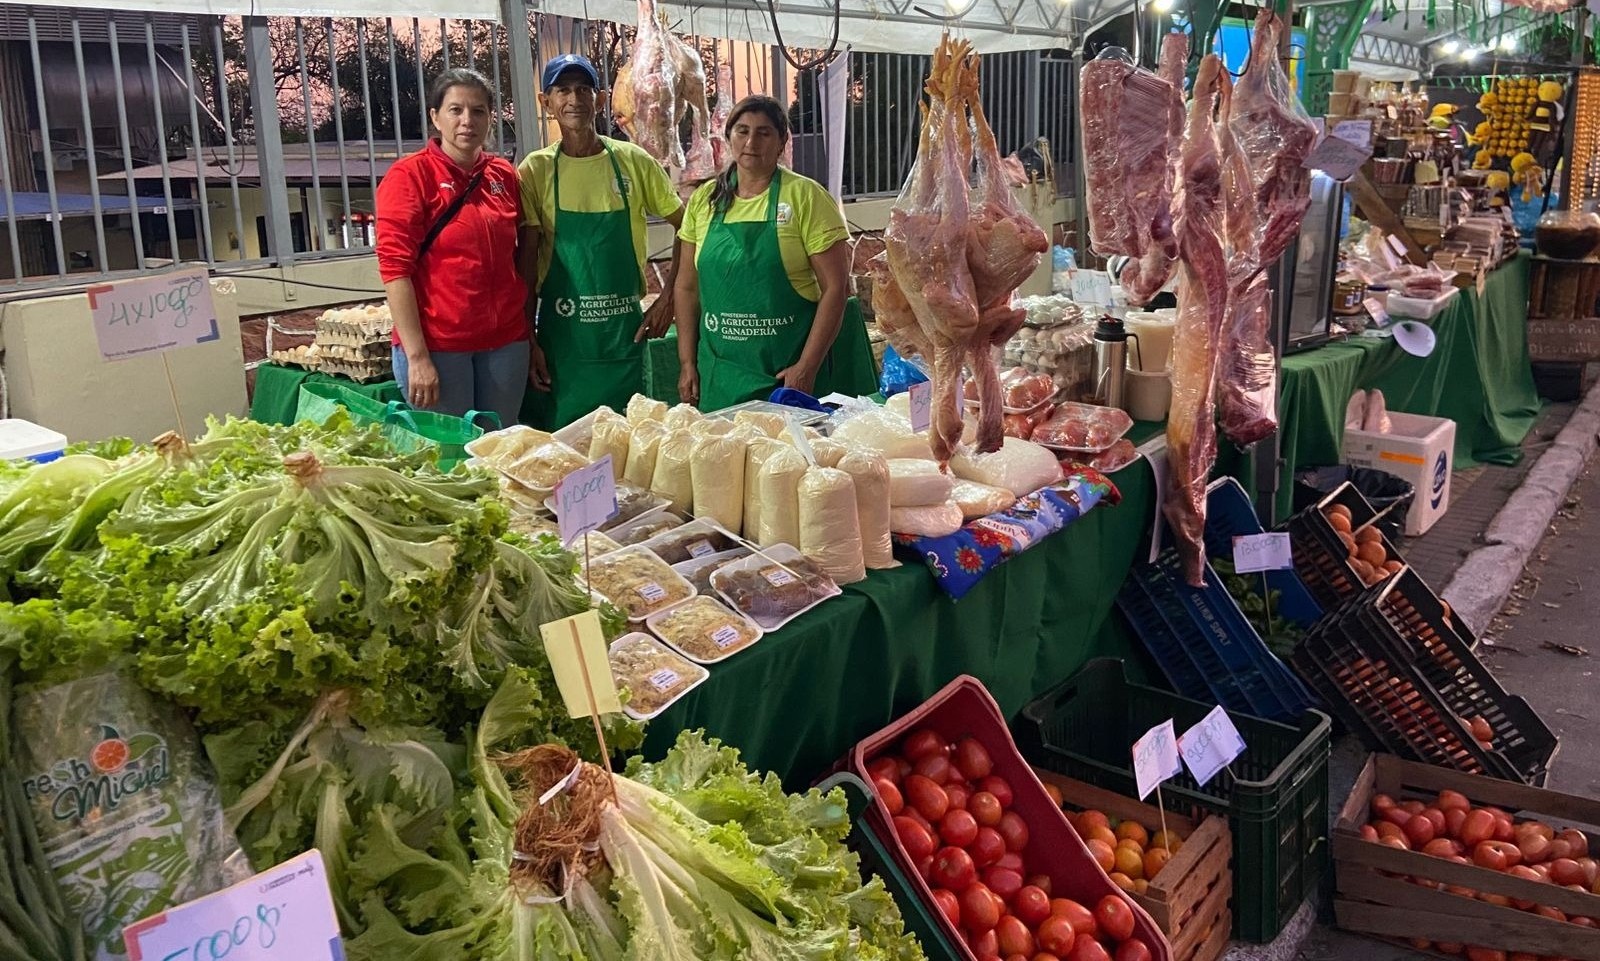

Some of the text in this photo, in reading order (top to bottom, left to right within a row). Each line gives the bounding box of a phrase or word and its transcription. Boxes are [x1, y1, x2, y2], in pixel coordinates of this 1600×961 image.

[579, 305, 634, 318] GANADERÍA
[720, 317, 788, 327] AGRICULTURA
[721, 326, 777, 336] GANADERÍA
[1210, 621, 1232, 647] SUPPLY
[22, 758, 91, 800] resh
